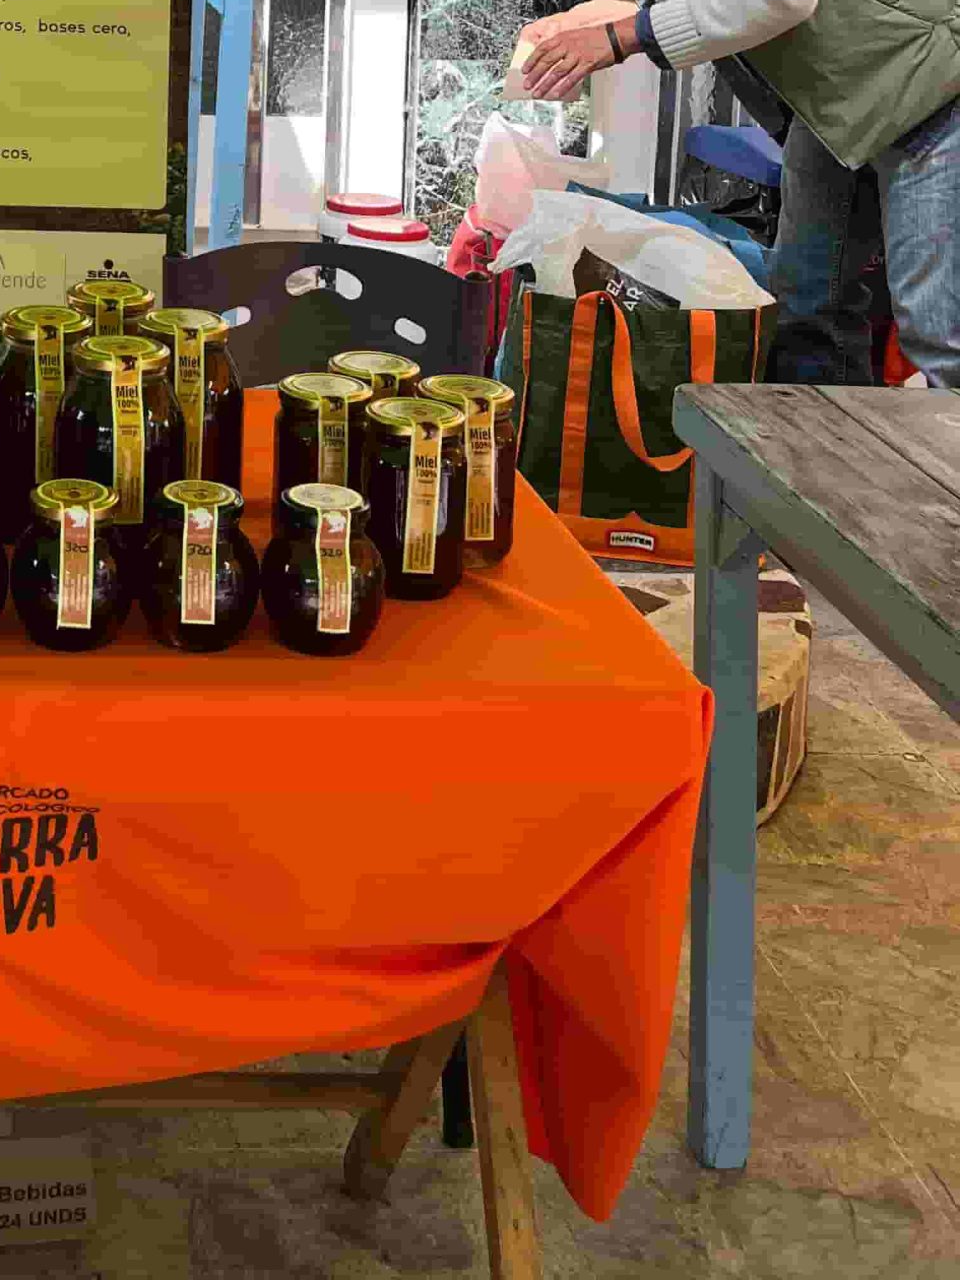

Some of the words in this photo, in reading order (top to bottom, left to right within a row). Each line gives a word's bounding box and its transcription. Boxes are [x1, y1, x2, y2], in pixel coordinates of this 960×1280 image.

[38, 19, 86, 35] bases
[92, 23, 132, 38] cera,
[87, 271, 130, 280] SENA
[40, 354, 60, 366] Miel
[179, 355, 200, 367] Miel
[116, 385, 138, 397] Miel
[470, 427, 491, 440] Miel
[415, 456, 437, 468] Miel
[612, 536, 651, 546] HUNTER
[29, 1208, 87, 1226] UNDS
